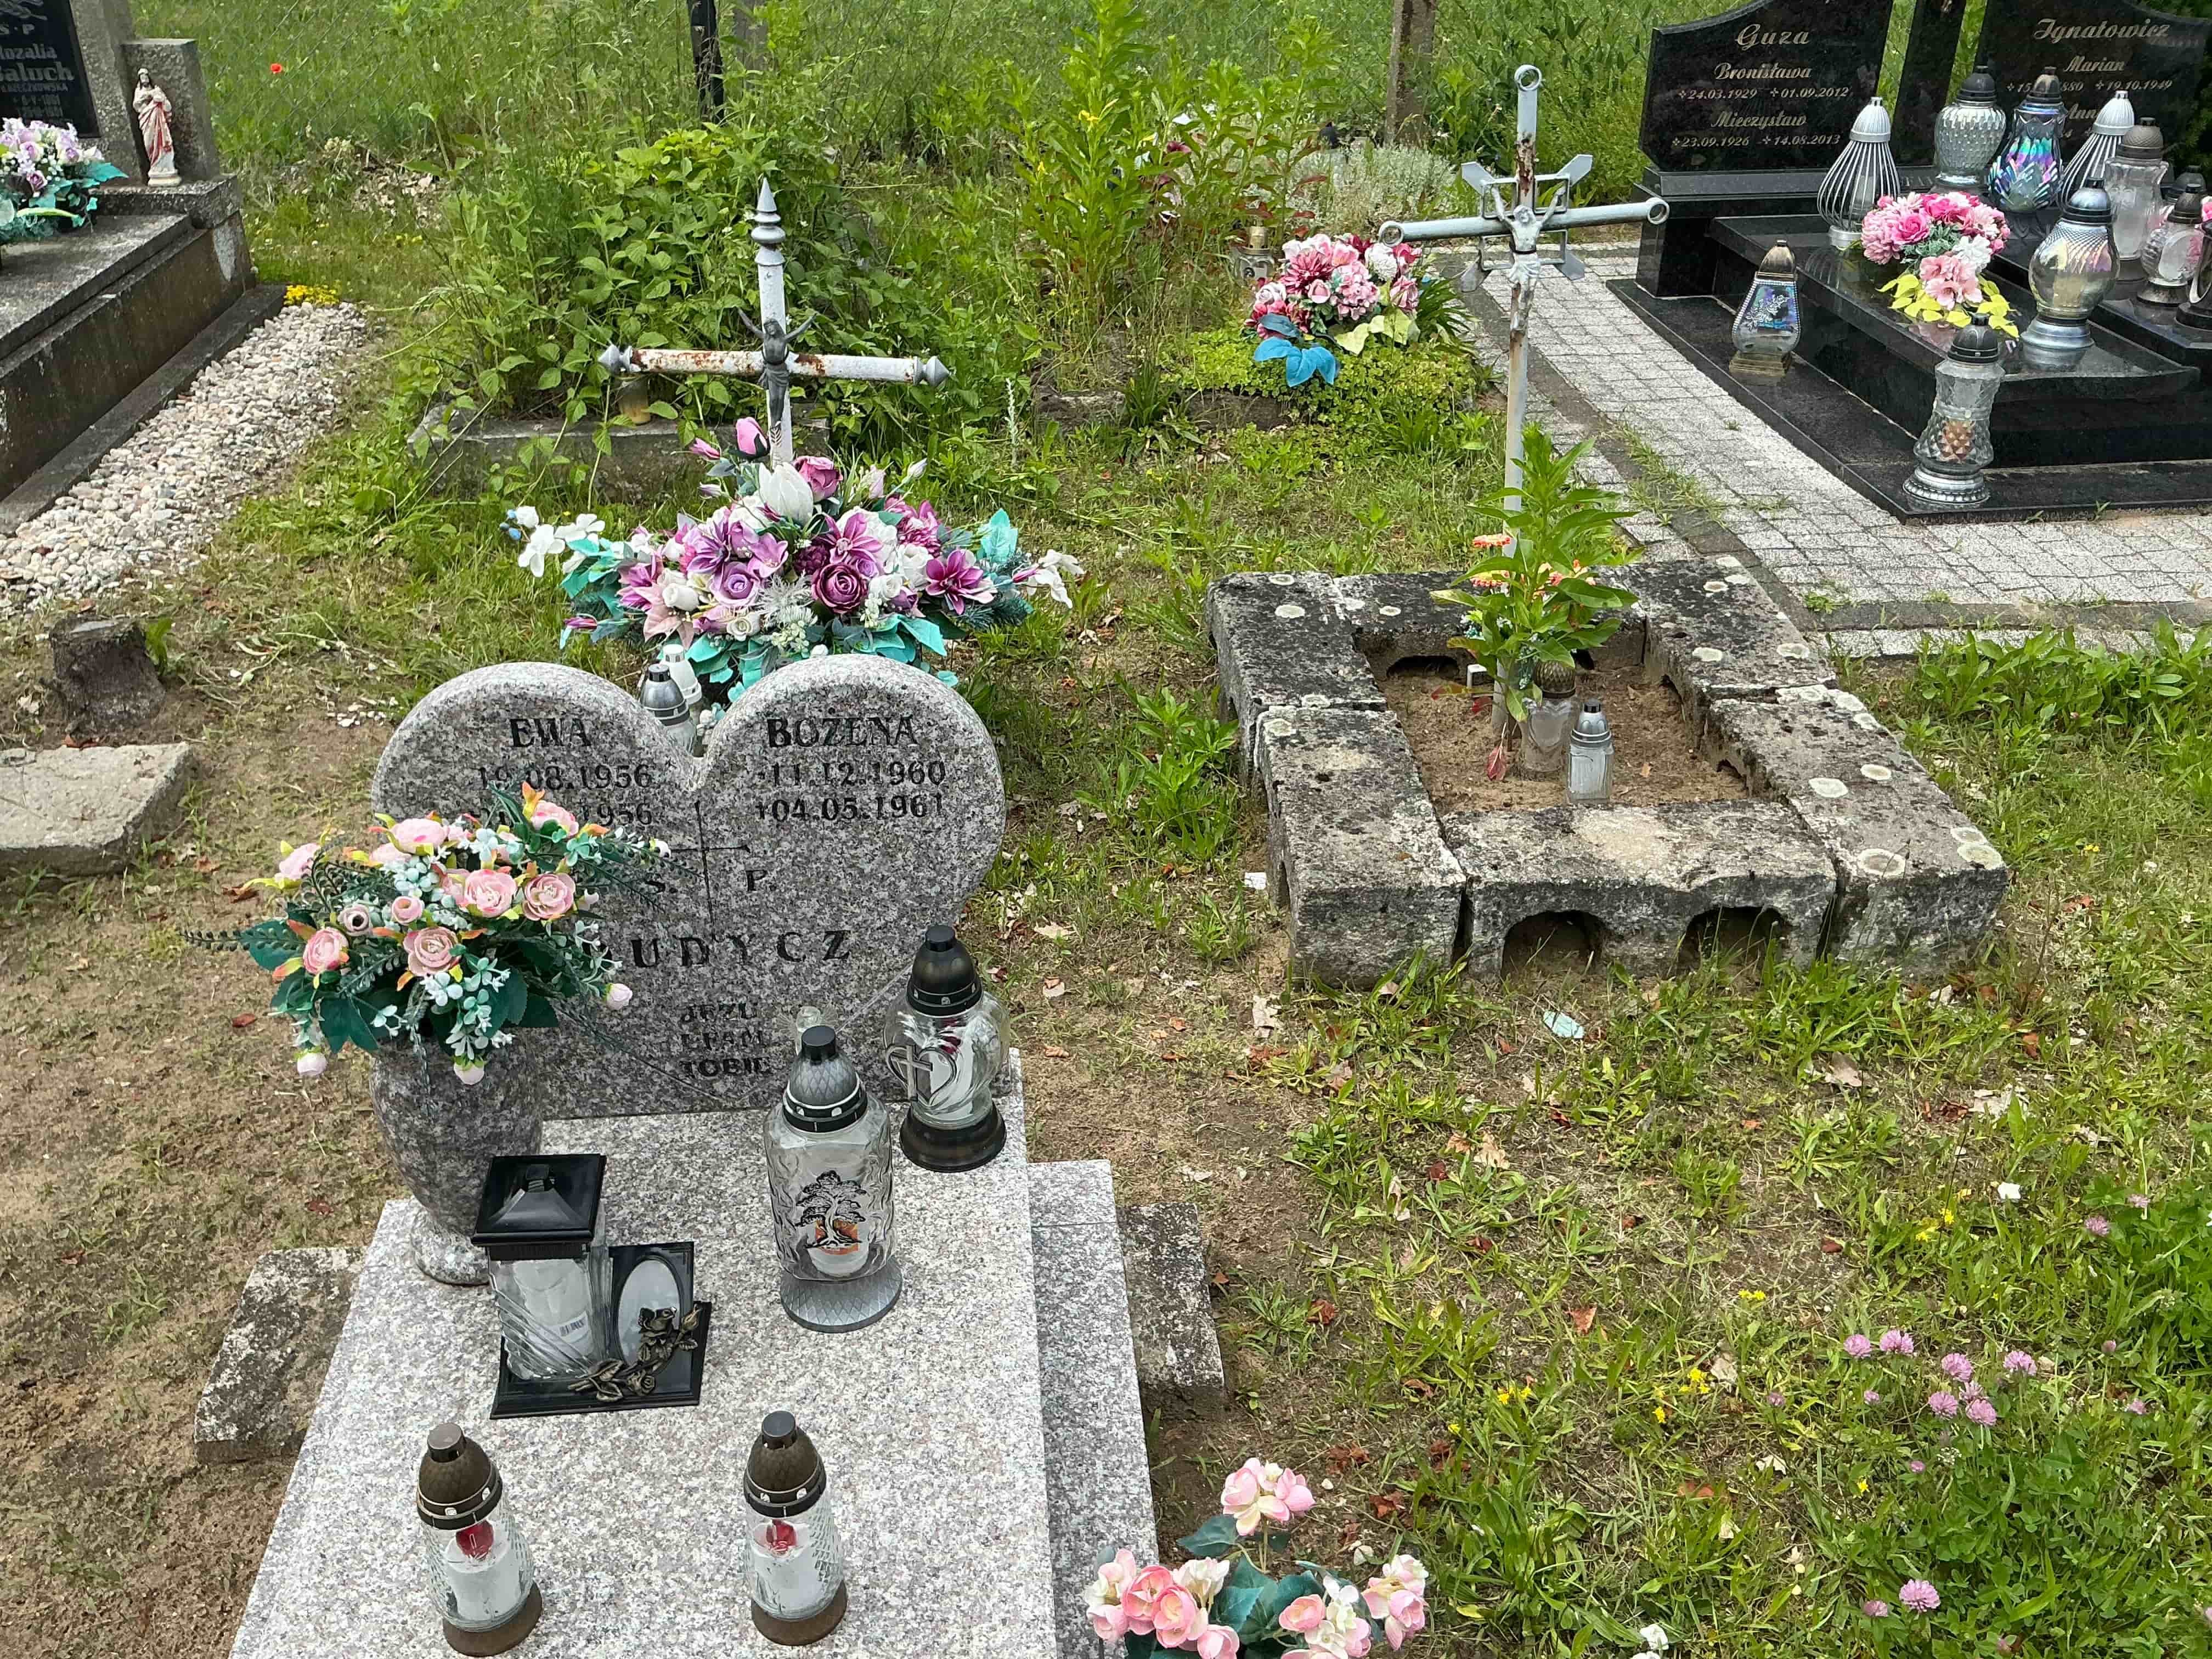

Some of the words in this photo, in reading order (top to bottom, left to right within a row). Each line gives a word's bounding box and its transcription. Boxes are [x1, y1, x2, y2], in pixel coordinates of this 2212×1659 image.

[1735, 24, 1810, 50] Guza
[2033, 18, 2171, 43] Ignatowicz
[0, 43, 57, 60] ozalia
[1714, 62, 1813, 80] Bronisława
[2064, 55, 2126, 73] Marian
[1781, 87, 1849, 98] 01.09.2012
[1711, 110, 1807, 130] Mieczysław
[2066, 103, 2098, 119] Ann
[509, 718, 592, 747] EWA
